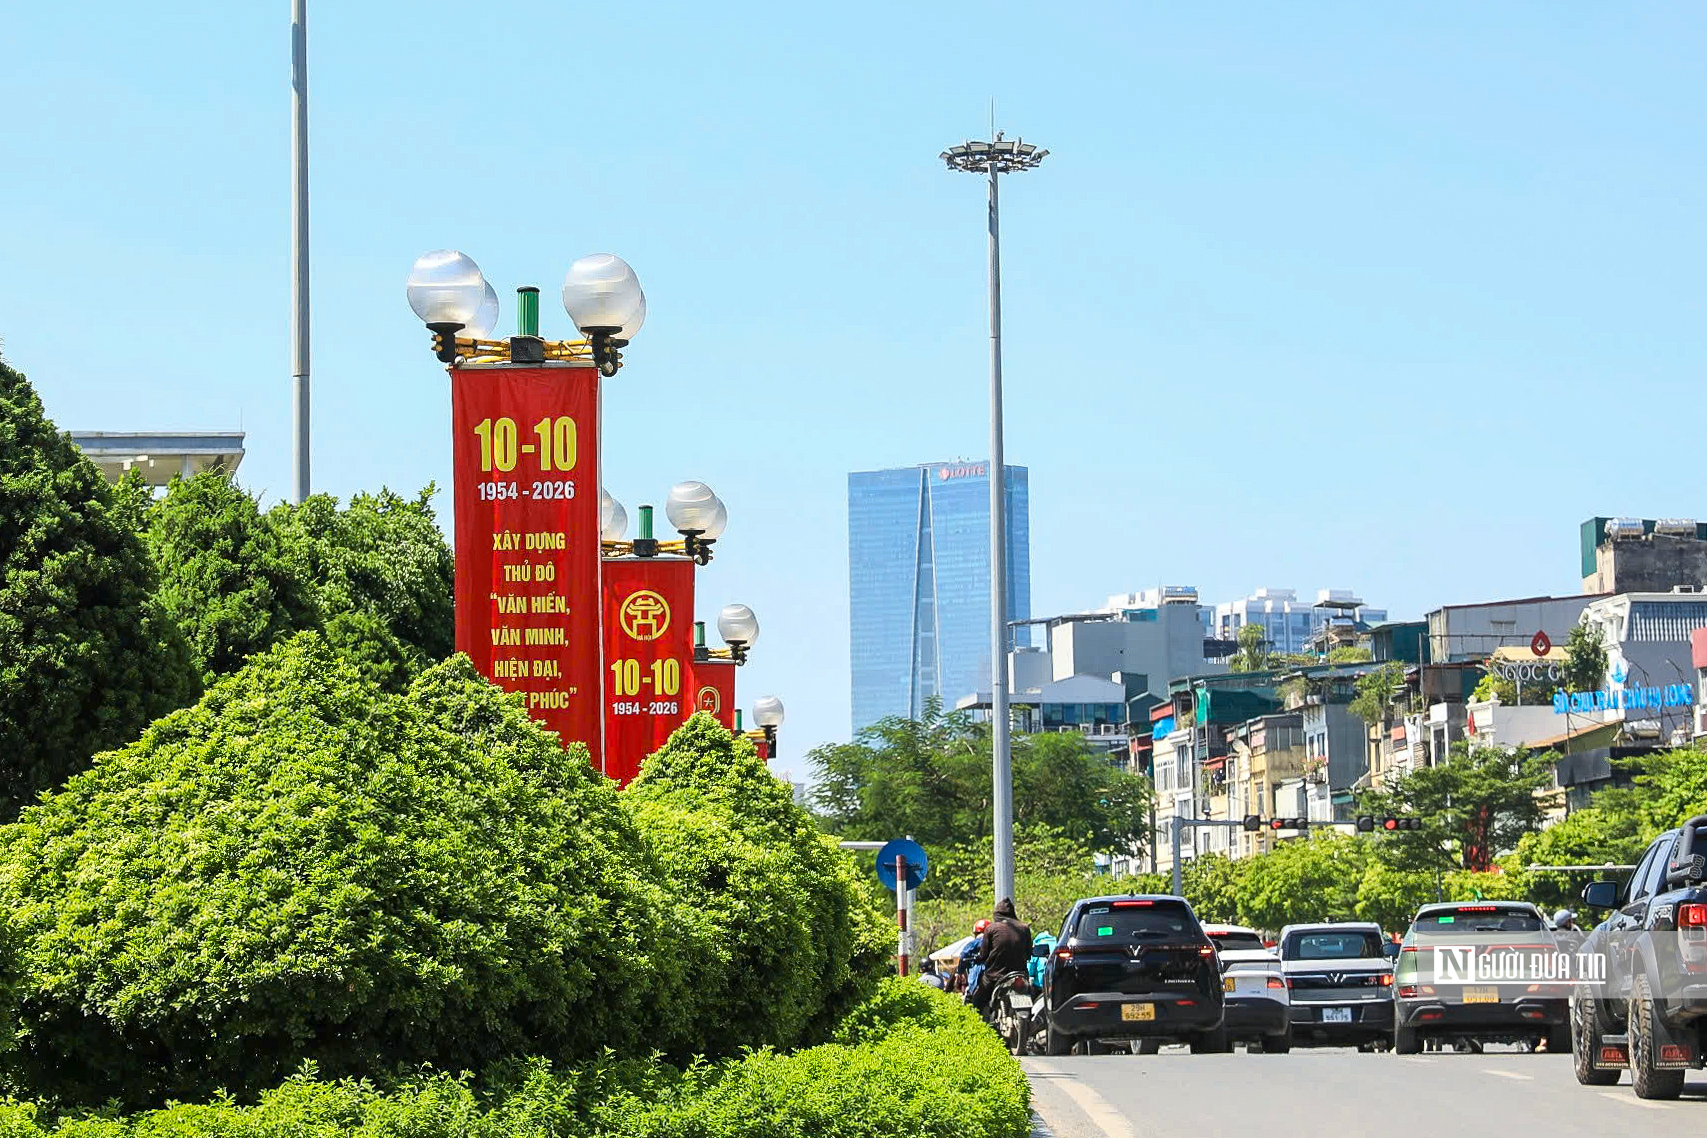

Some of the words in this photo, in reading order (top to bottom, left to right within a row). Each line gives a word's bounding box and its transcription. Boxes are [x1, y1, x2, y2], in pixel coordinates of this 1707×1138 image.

[474, 416, 577, 472] 10-10
[492, 530, 521, 550] XÂY
[525, 531, 566, 553] DỰNG
[503, 560, 531, 582] THỦ
[535, 561, 555, 582] ĐÔ
[531, 591, 571, 615] HIẾN,
[491, 625, 521, 646] VĂN
[525, 627, 569, 648] MINH,
[494, 657, 529, 681] HIỆN
[533, 659, 562, 681] ĐẠI,
[611, 658, 680, 696] 10-10
